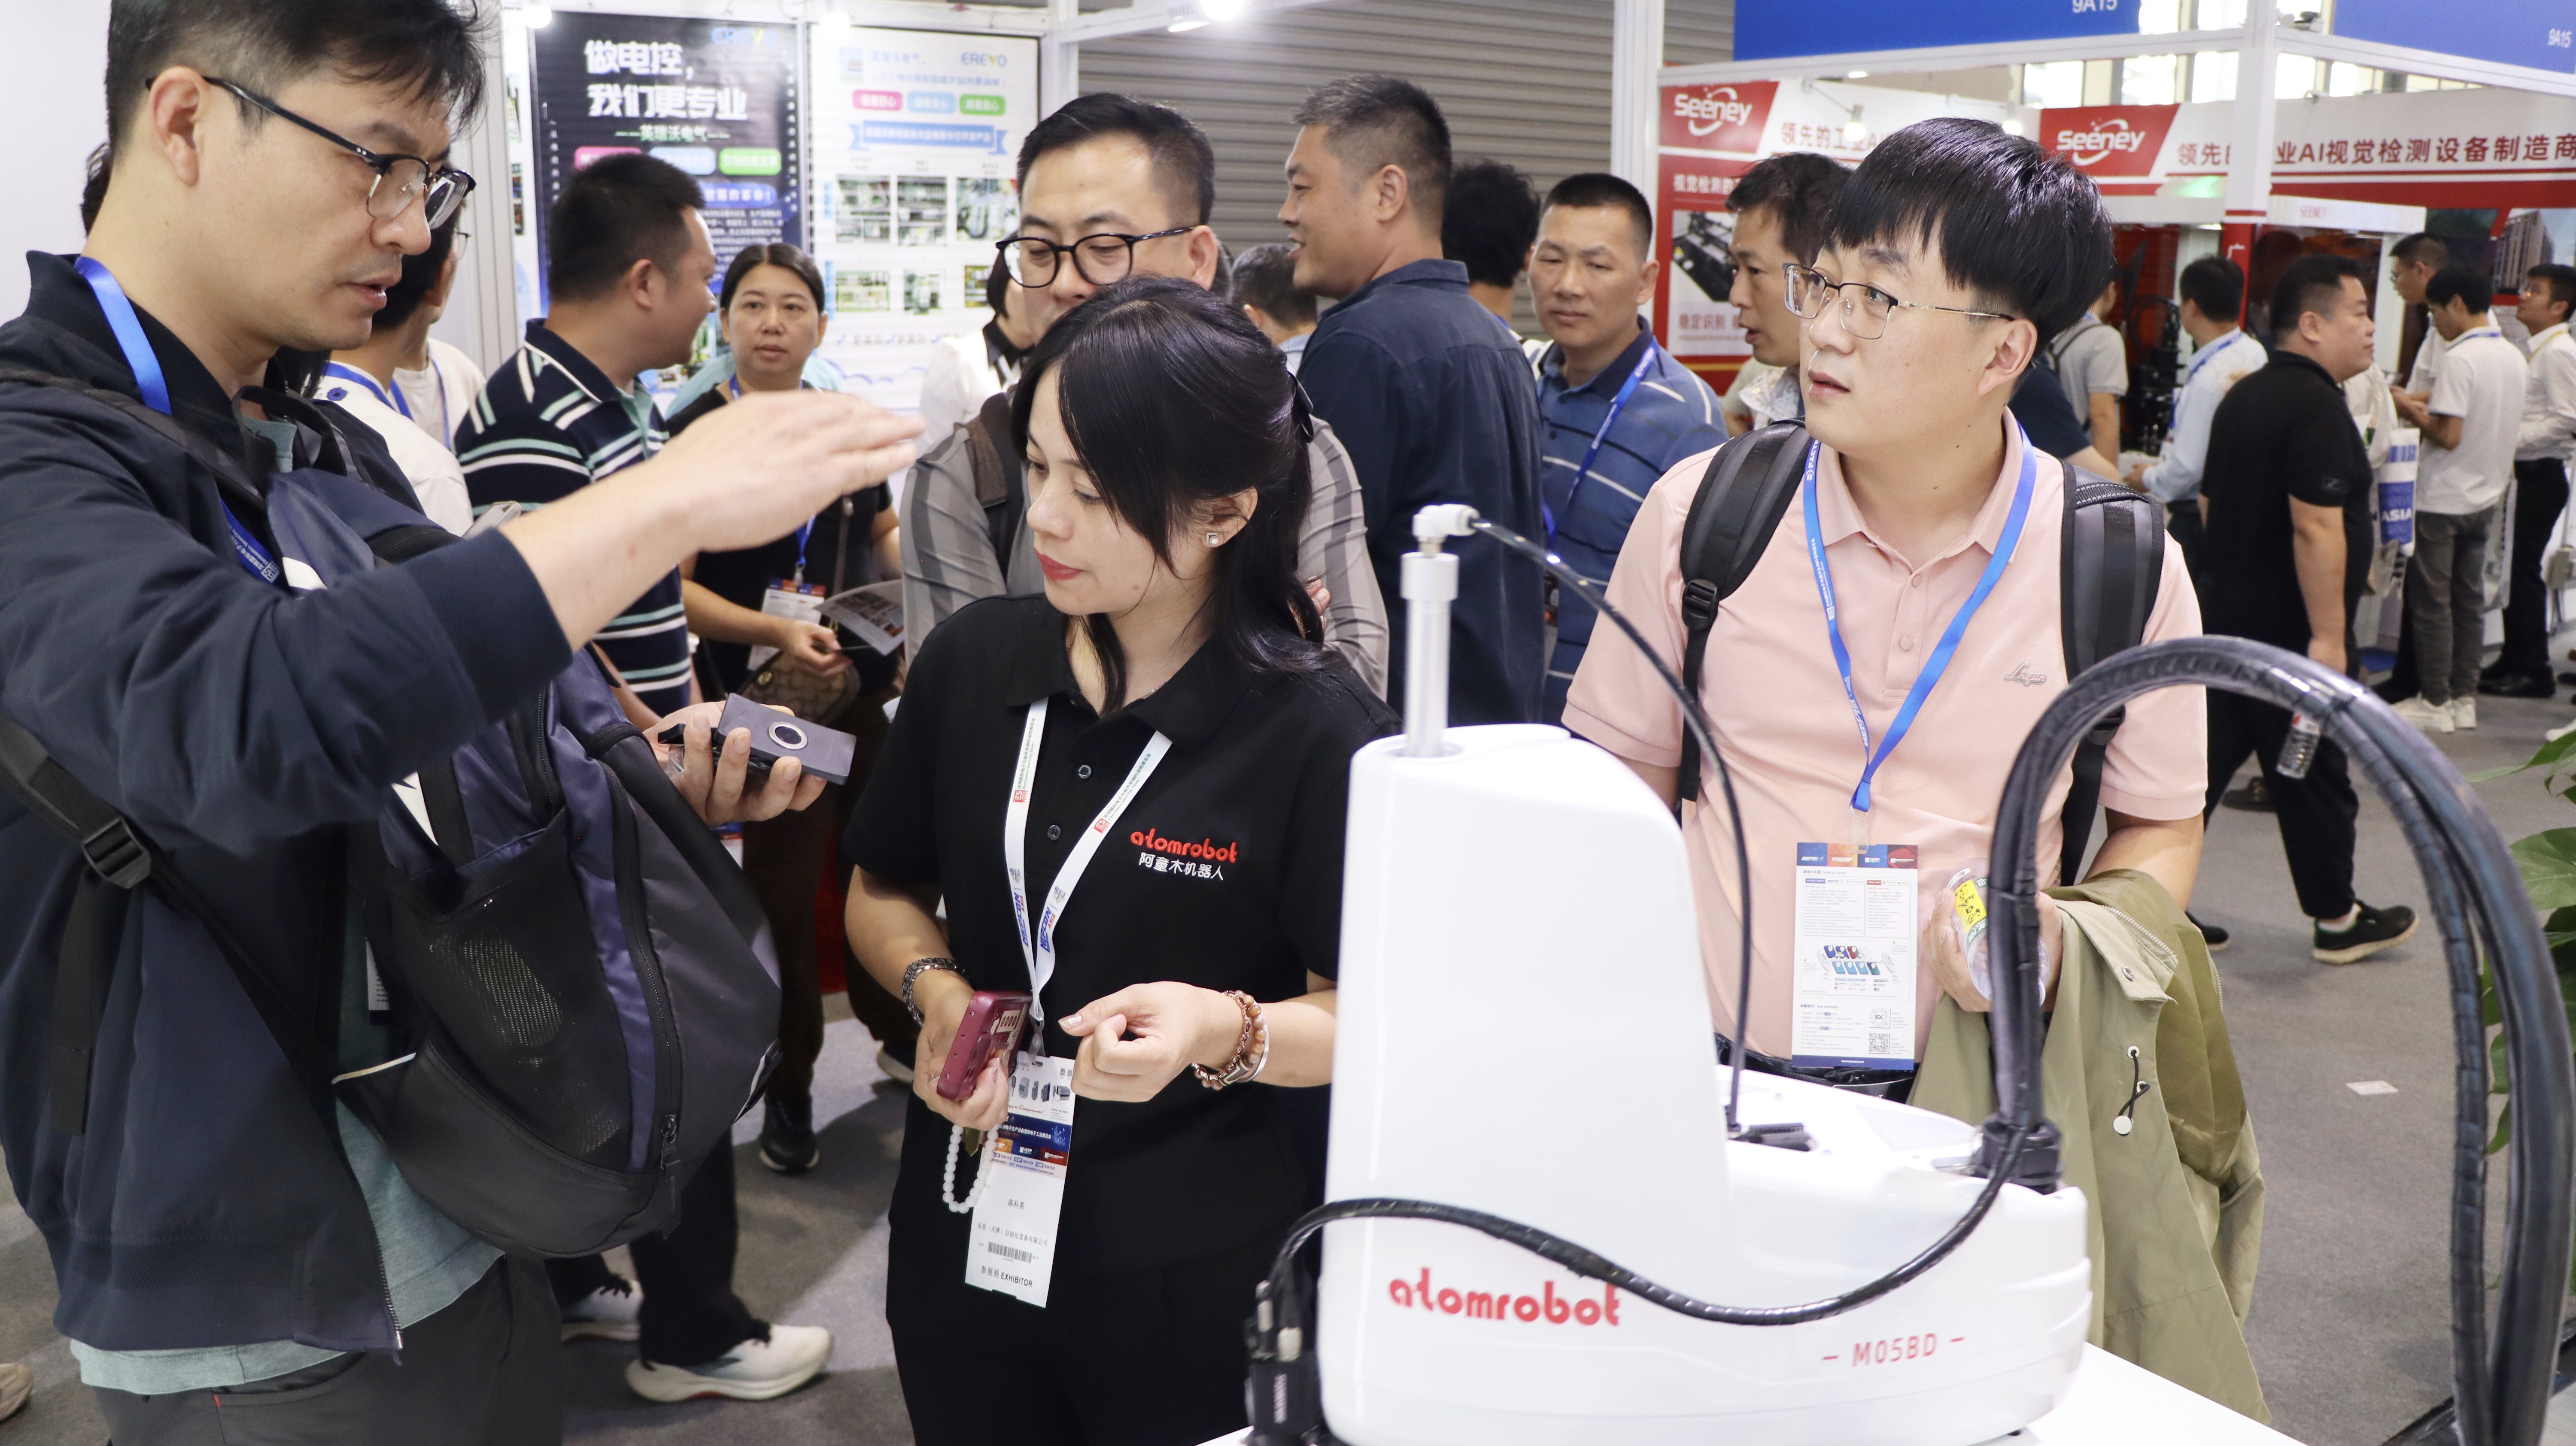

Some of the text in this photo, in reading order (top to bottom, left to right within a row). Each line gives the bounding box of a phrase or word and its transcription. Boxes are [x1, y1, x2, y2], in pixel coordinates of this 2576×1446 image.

[2549, 28, 2572, 48] 9A15
[962, 52, 1007, 67] EREVO
[587, 84, 748, 121] 我们更专业
[1015, 790, 1023, 800] ES
[1096, 818, 1106, 829] ES
[1130, 828, 1237, 863] atomrobot
[1139, 852, 1224, 881] 阿童木机器人
[1014, 892, 1029, 947] NEPCON
[1039, 906, 1051, 952] NEPCON
[1048, 913, 1056, 930] ASIA
[981, 1265, 1033, 1288] 参展商 EXHIBITOR
[1389, 1267, 1620, 1326] atomrobot
[1852, 1333, 1938, 1368] M05BD
